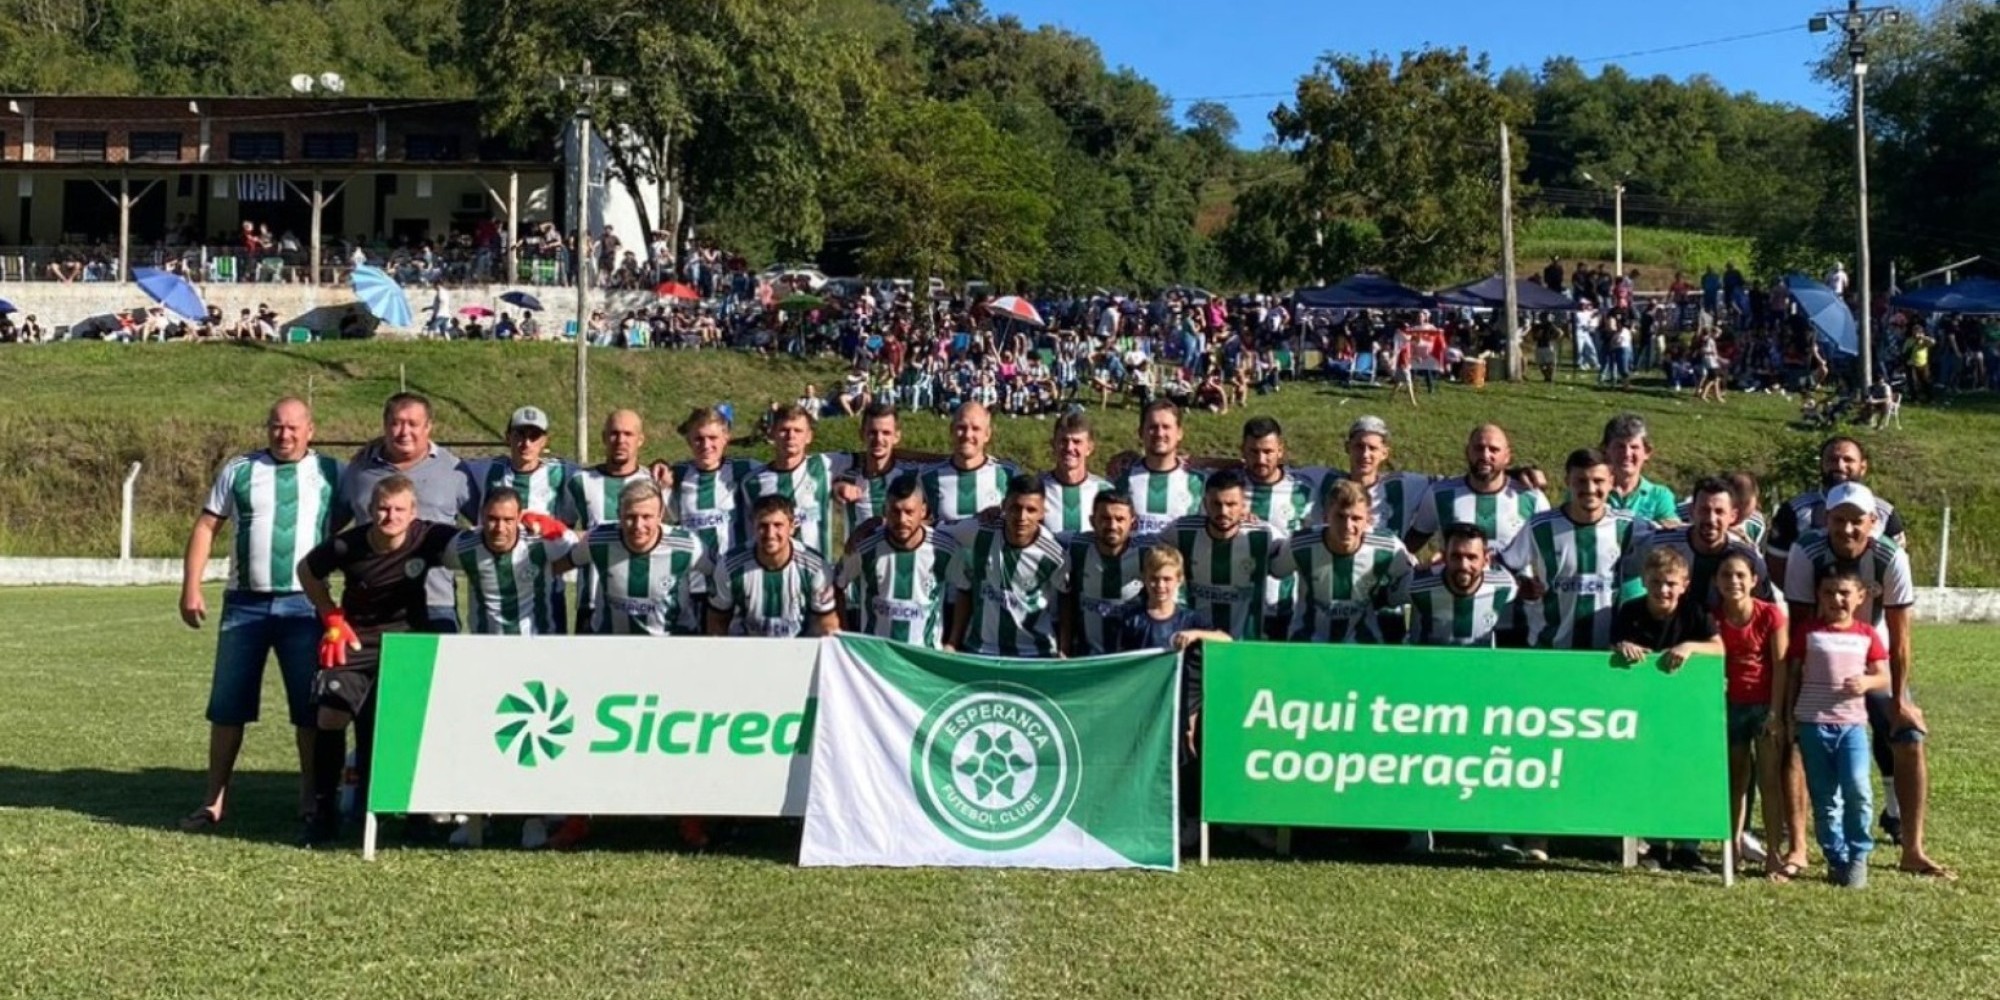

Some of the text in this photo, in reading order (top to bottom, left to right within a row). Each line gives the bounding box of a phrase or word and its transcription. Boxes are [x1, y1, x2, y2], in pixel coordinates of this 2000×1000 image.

[1555, 579, 1604, 593] POTRICH
[944, 703, 1050, 749] ESPERANÇA
[1243, 689, 1638, 740] Aqui tem nossa
[1245, 745, 1564, 800] cooperação!
[941, 783, 1043, 825] FUTEBOL CLUBE
